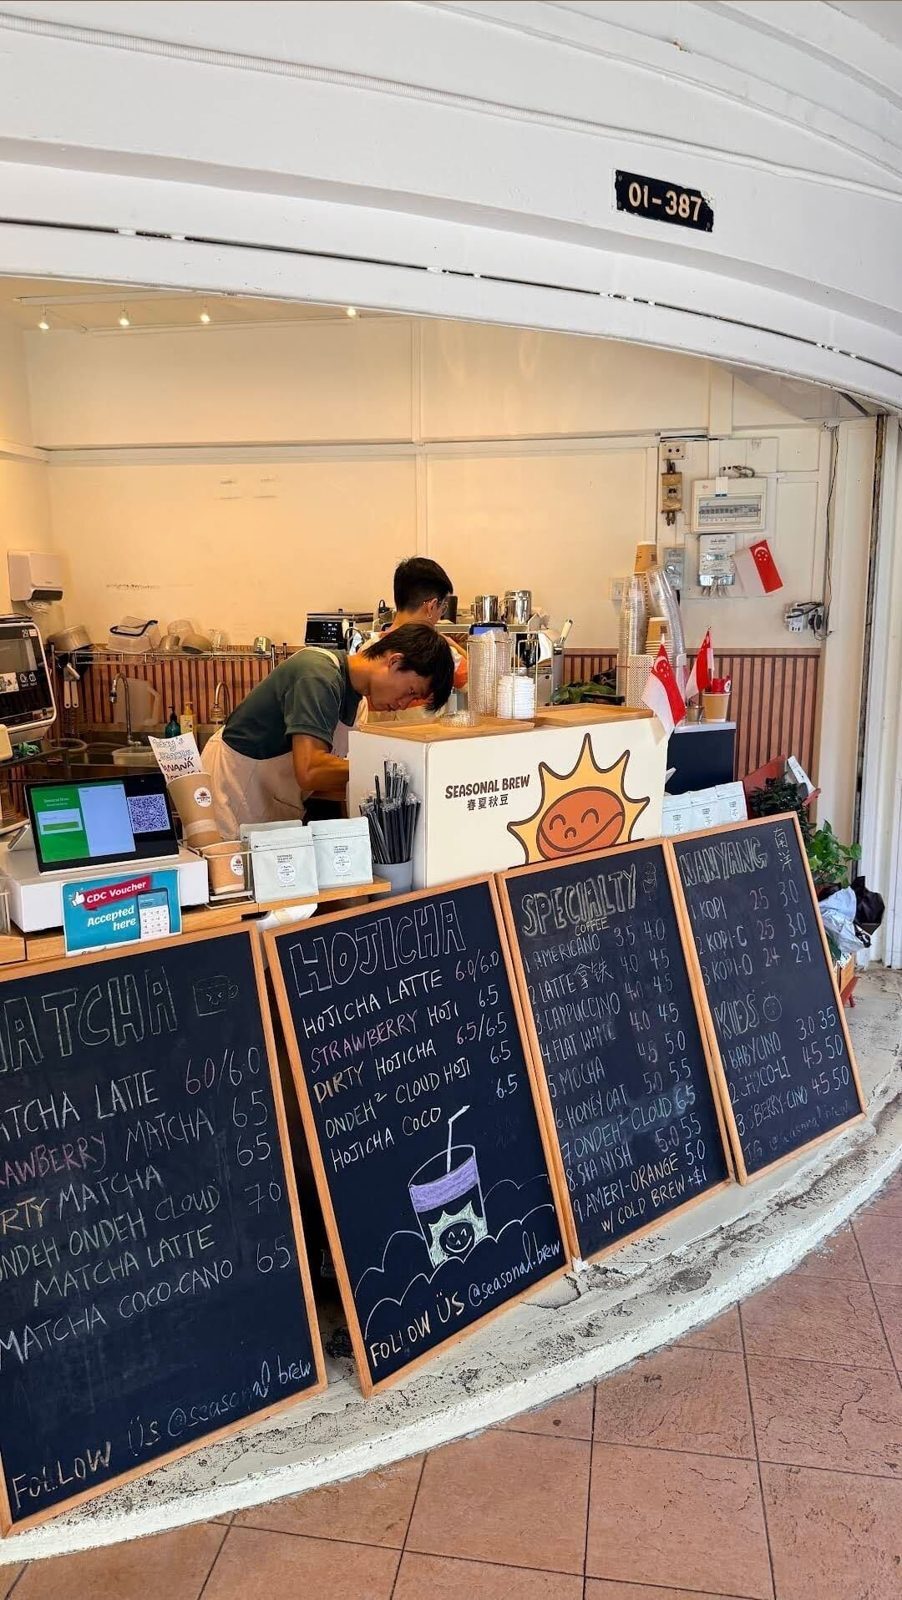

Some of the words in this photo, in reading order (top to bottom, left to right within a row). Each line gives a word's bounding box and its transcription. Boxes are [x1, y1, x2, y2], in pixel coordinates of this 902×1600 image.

[629, 182, 703, 221] 01-387
[445, 780, 500, 799] SEASONAL
[501, 774, 531, 791] BREW
[467, 793, 509, 811] 春夏秋豆
[679, 836, 769, 887] NANYANG
[86, 891, 107, 904] CDC
[109, 881, 147, 897] Voucher
[521, 863, 638, 937] SPECIALTY
[699, 894, 728, 921] KOPI
[87, 905, 135, 928] Accepted
[113, 917, 137, 931] here
[574, 917, 610, 937] COFFEE
[704, 925, 749, 953] KOPI-C
[289, 900, 467, 998] HOJICHA
[533, 933, 601, 970] AMERICANO
[302, 993, 382, 1040] HOJICHA
[387, 968, 443, 1005] LATTE
[538, 972, 577, 1004] LATTE
[544, 991, 621, 1031] CAPPUCCINO
[0, 966, 178, 1073] ATCHA
[311, 1010, 419, 1074] STRAWBERRY
[427, 1000, 459, 1027] HOJI
[478, 984, 499, 1008] 6.5
[714, 993, 760, 1040] KIDS
[552, 1032, 578, 1062] FLAT
[728, 1031, 781, 1071] BABYCINO
[94, 1069, 159, 1120] LATTE
[313, 1061, 364, 1105] DIRTY
[375, 1038, 437, 1081] HOJICHA
[395, 1072, 440, 1105] CLOUD
[444, 1057, 471, 1086] HOJI
[490, 1040, 512, 1065] 6.5
[558, 1055, 606, 1095] MOCHA
[330, 1126, 395, 1173] HOJICHA
[402, 1107, 442, 1136] COCO
[496, 1073, 519, 1099] 6.5
[565, 1089, 604, 1130] HONEY
[606, 1083, 629, 1113] OAT
[630, 1097, 672, 1130] CLOUD
[0, 1131, 107, 1189] AWBERRY
[125, 1107, 214, 1162] MATCHA
[59, 1164, 163, 1221] MATCHA
[617, 1197, 646, 1225] COLD
[649, 1175, 686, 1208] BREW
[0, 1236, 60, 1281] NDEH
[69, 1208, 148, 1256] ONDEH
[154, 1184, 221, 1221] CLOUD
[33, 1249, 140, 1307] MATCHA
[147, 1223, 215, 1268] LATTE
